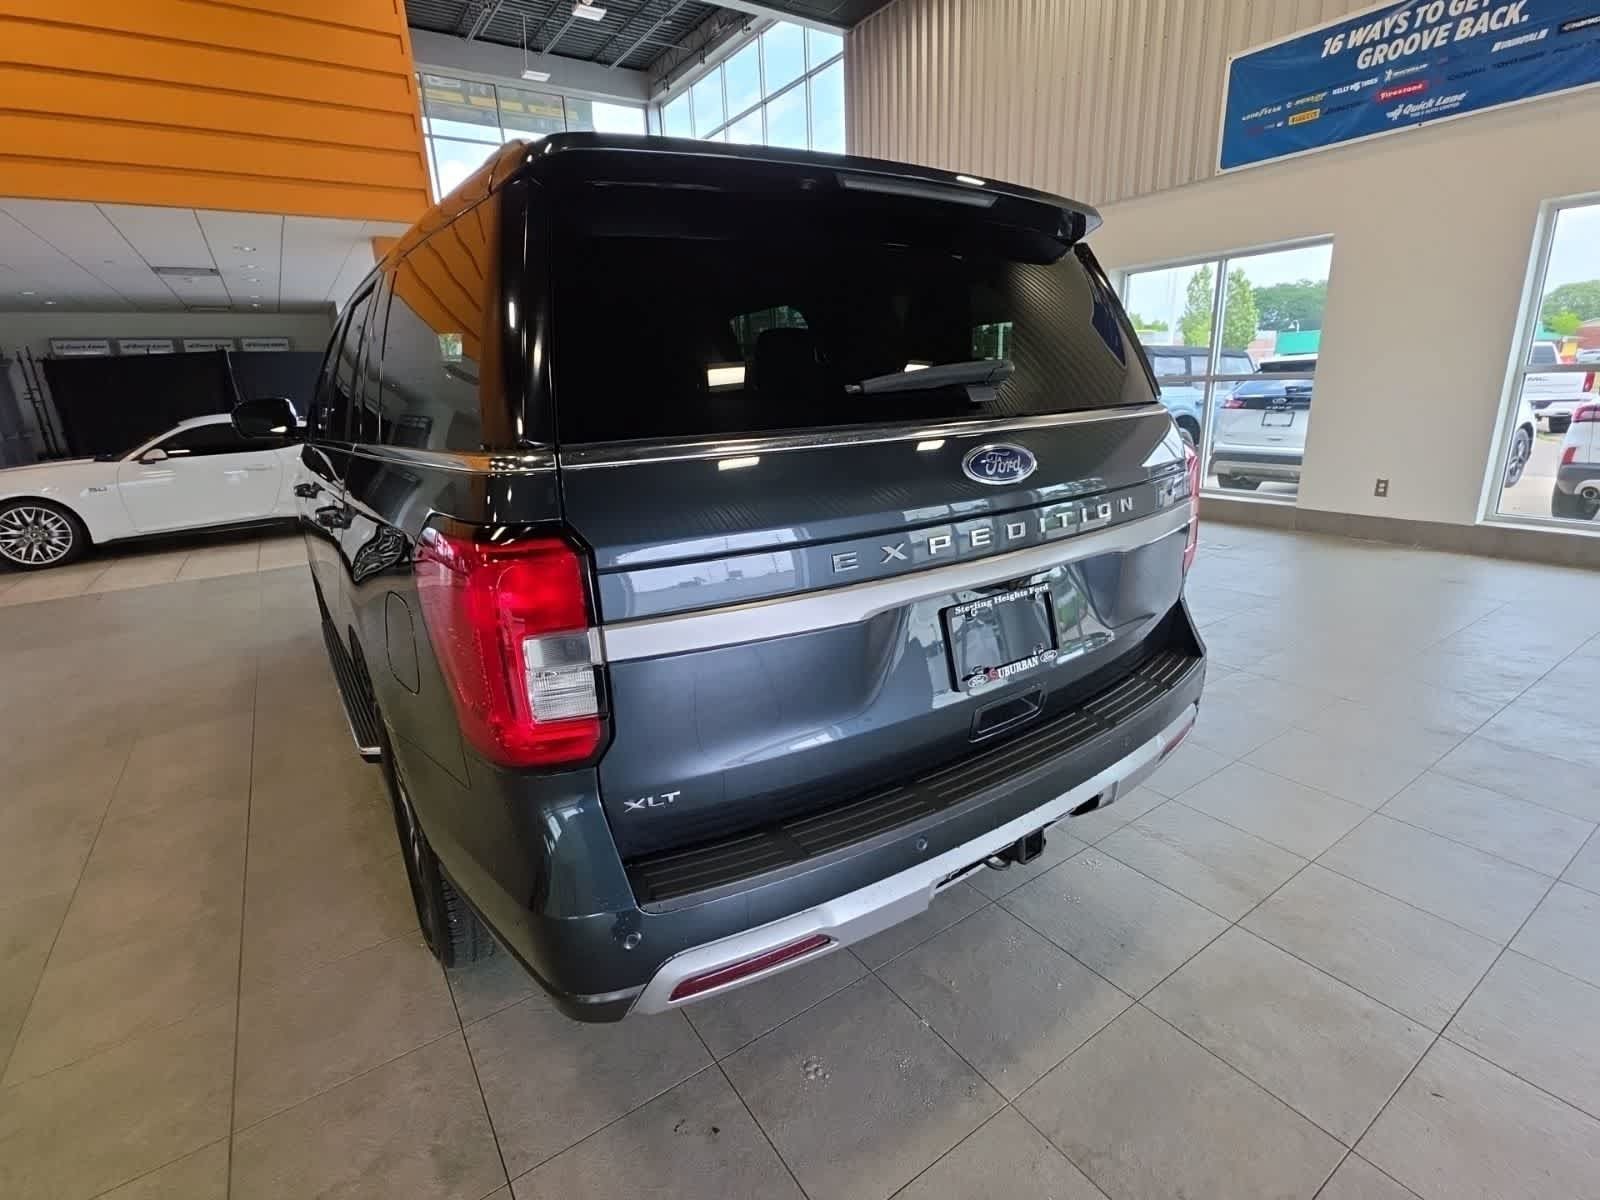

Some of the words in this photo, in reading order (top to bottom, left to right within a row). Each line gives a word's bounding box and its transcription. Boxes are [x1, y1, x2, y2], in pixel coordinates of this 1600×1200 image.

[1321, 33, 1345, 58] 16
[1347, 11, 1411, 49] WAYS
[1414, 0, 1446, 29] TO
[1357, 22, 1453, 70] GROOVE
[1454, 0, 1530, 42] BACK.
[1403, 98, 1435, 115] Quick
[1435, 92, 1466, 108] Lane
[980, 451, 1022, 475] Ford
[831, 496, 1133, 573] EXPEDITION
[955, 600, 992, 615] Sterling
[994, 589, 1028, 604] Heights
[1029, 583, 1049, 595] Ford
[989, 656, 1039, 680] SUBURBAN
[624, 790, 681, 813] XLT
